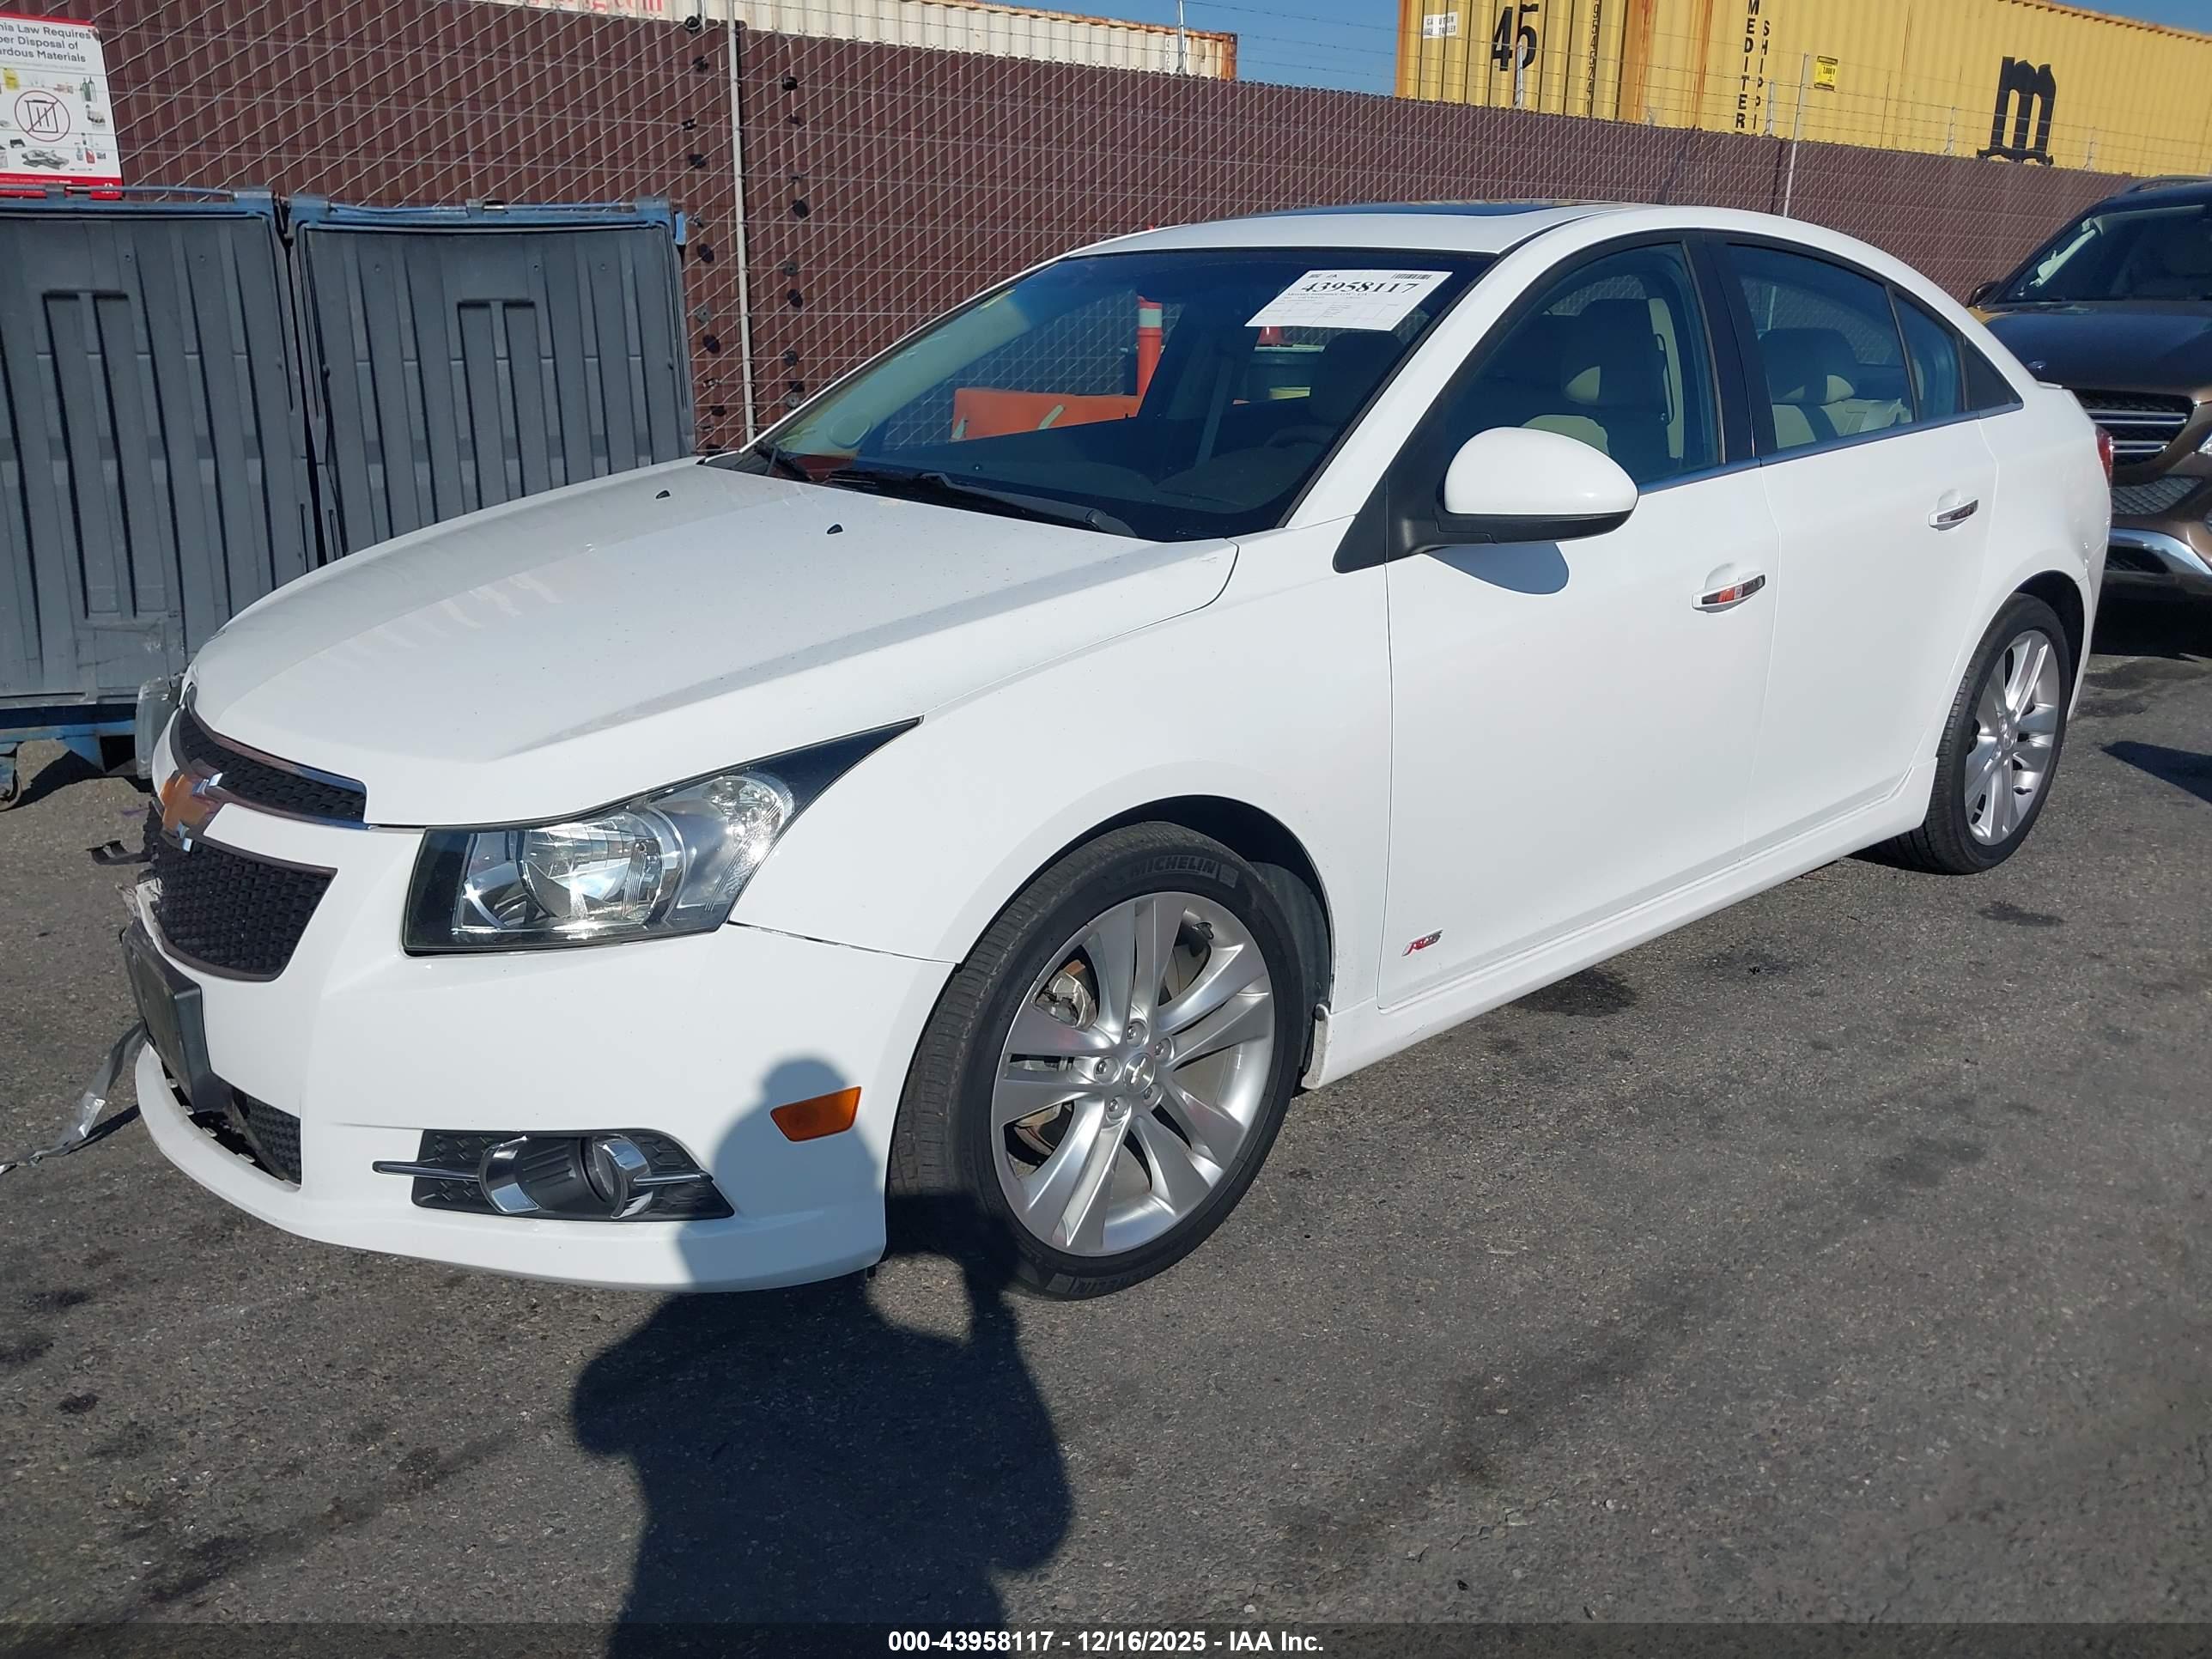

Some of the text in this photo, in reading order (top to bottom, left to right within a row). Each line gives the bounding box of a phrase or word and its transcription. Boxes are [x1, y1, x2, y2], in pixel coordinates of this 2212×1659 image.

[17, 24, 40, 33] Law
[43, 27, 91, 40] Requires
[1492, 3, 1540, 71] 45
[18, 36, 65, 48] Disposal
[69, 41, 79, 50] of
[37, 50, 86, 63] Materials
[1301, 281, 1419, 293] 43958117
[1131, 855, 1218, 880] MICHELIN
